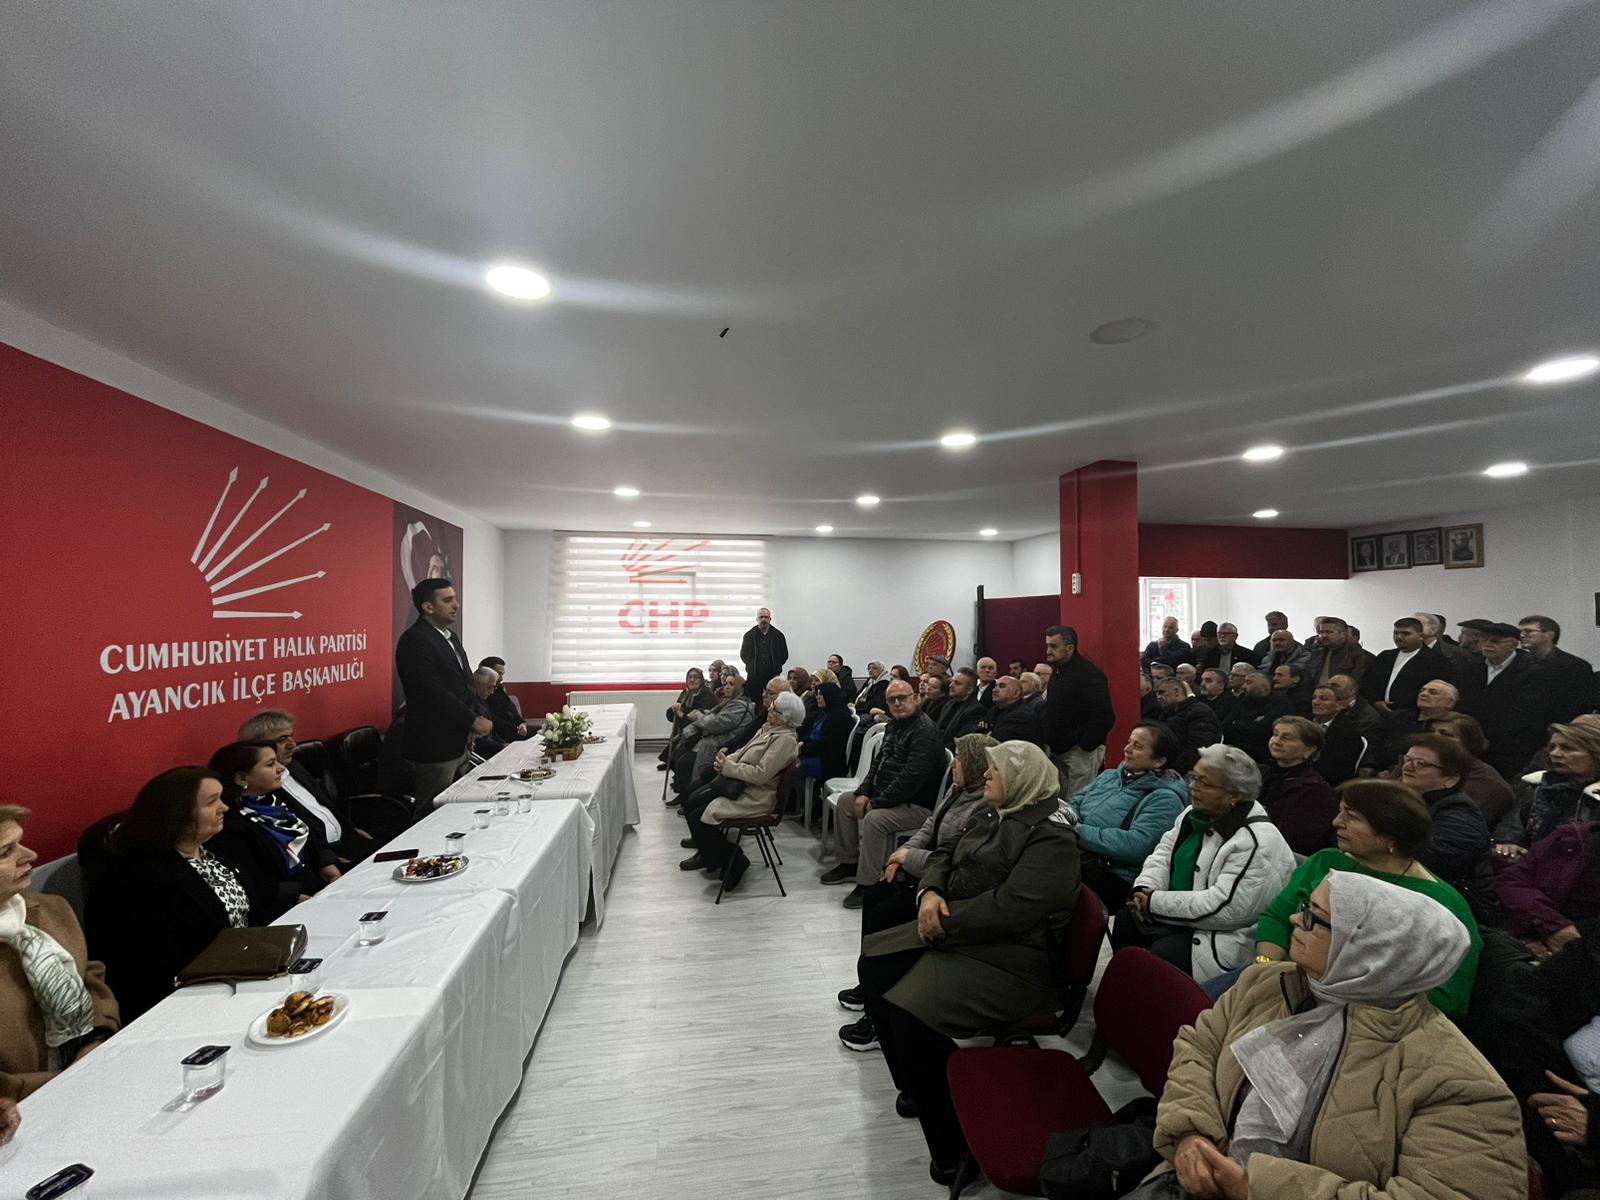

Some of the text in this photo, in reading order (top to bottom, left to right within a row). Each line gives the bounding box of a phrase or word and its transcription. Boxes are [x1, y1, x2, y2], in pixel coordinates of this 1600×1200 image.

[618, 600, 709, 634] CHP
[100, 629, 367, 675] CUMHURİYET HALK PARTİSİ
[108, 657, 364, 723] AYANCIK İLÇE BAŞKANLIĞI
